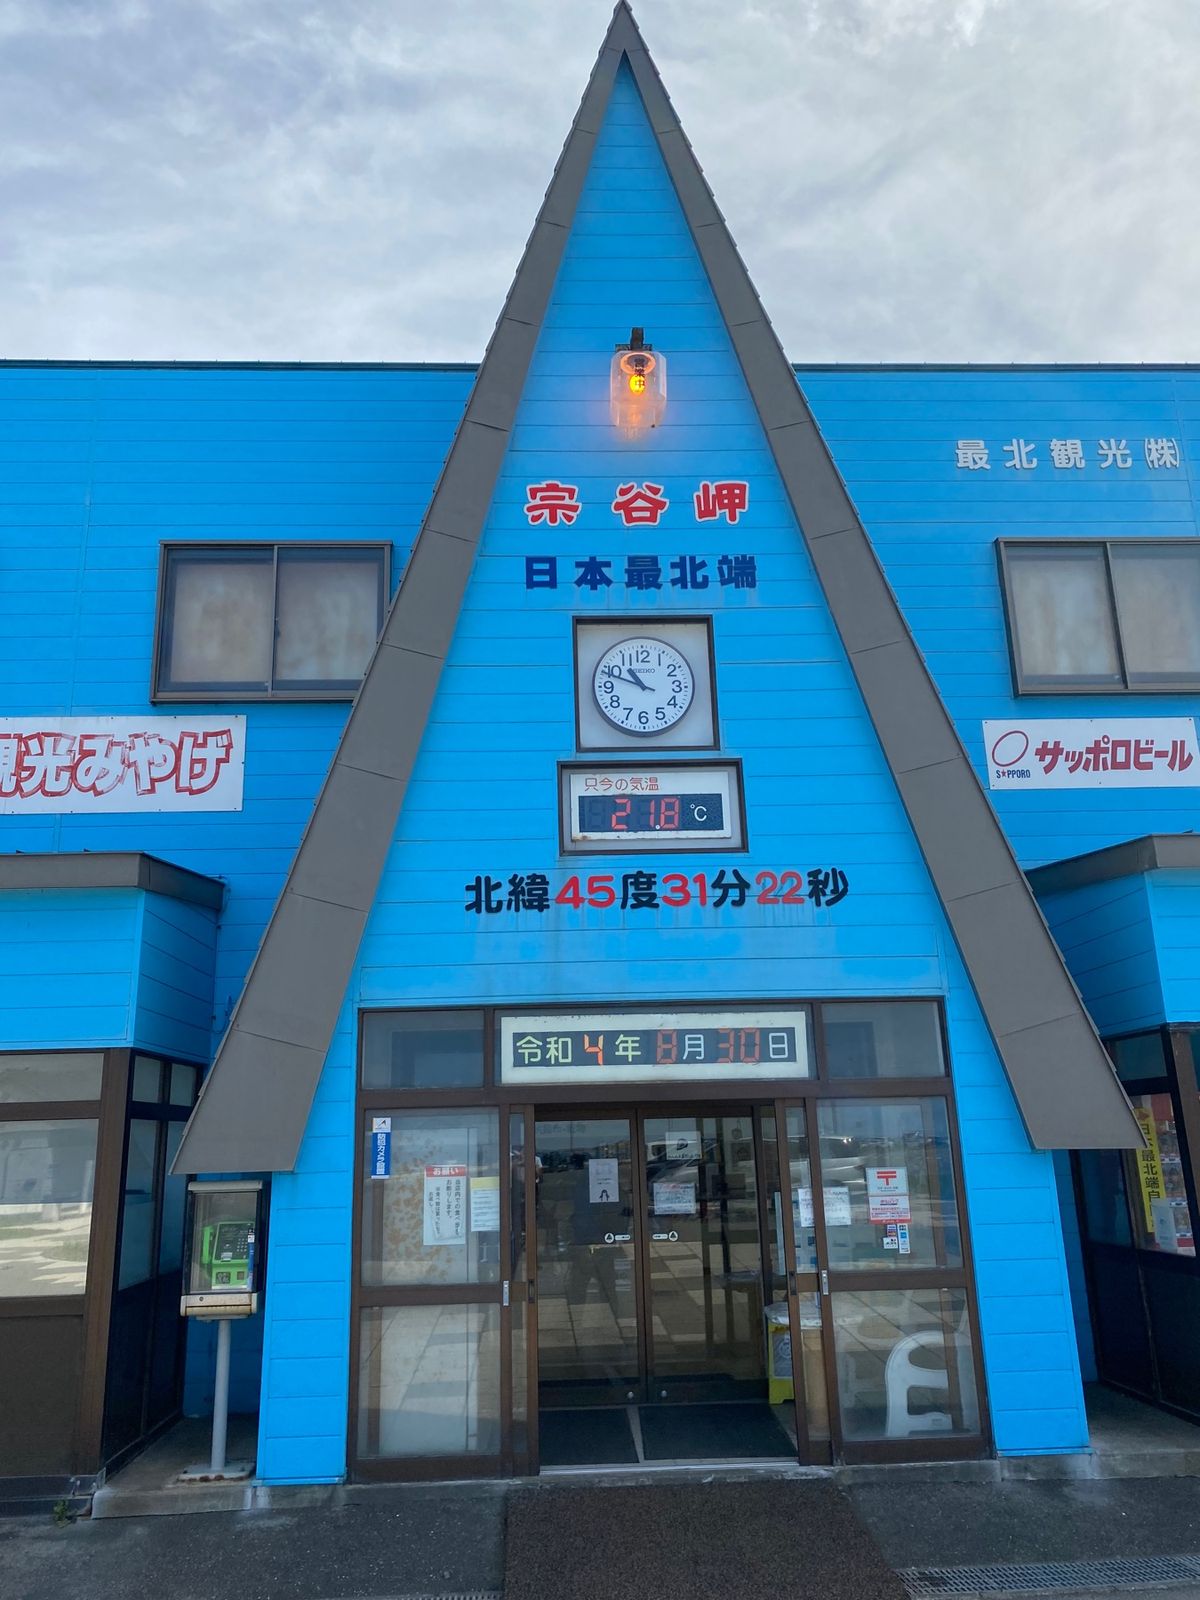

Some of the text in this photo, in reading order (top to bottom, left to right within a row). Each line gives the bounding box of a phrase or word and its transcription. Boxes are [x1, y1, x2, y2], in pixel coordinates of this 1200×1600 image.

[524, 480, 750, 526] 宗谷岬
[525, 555, 757, 590] 日本最北端
[635, 650, 650, 663] 12
[666, 664, 677, 677] 2
[603, 681, 614, 694] 9
[671, 680, 682, 693] 3
[609, 695, 620, 708] 8
[666, 695, 678, 708] 4
[623, 707, 633, 721] 7
[638, 711, 649, 725] 6
[655, 707, 666, 720] 5
[1034, 734, 1194, 774] サッポロビール
[584, 777, 660, 792] 只今の気温
[464, 868, 850, 914] 北緯45度31分22秒
